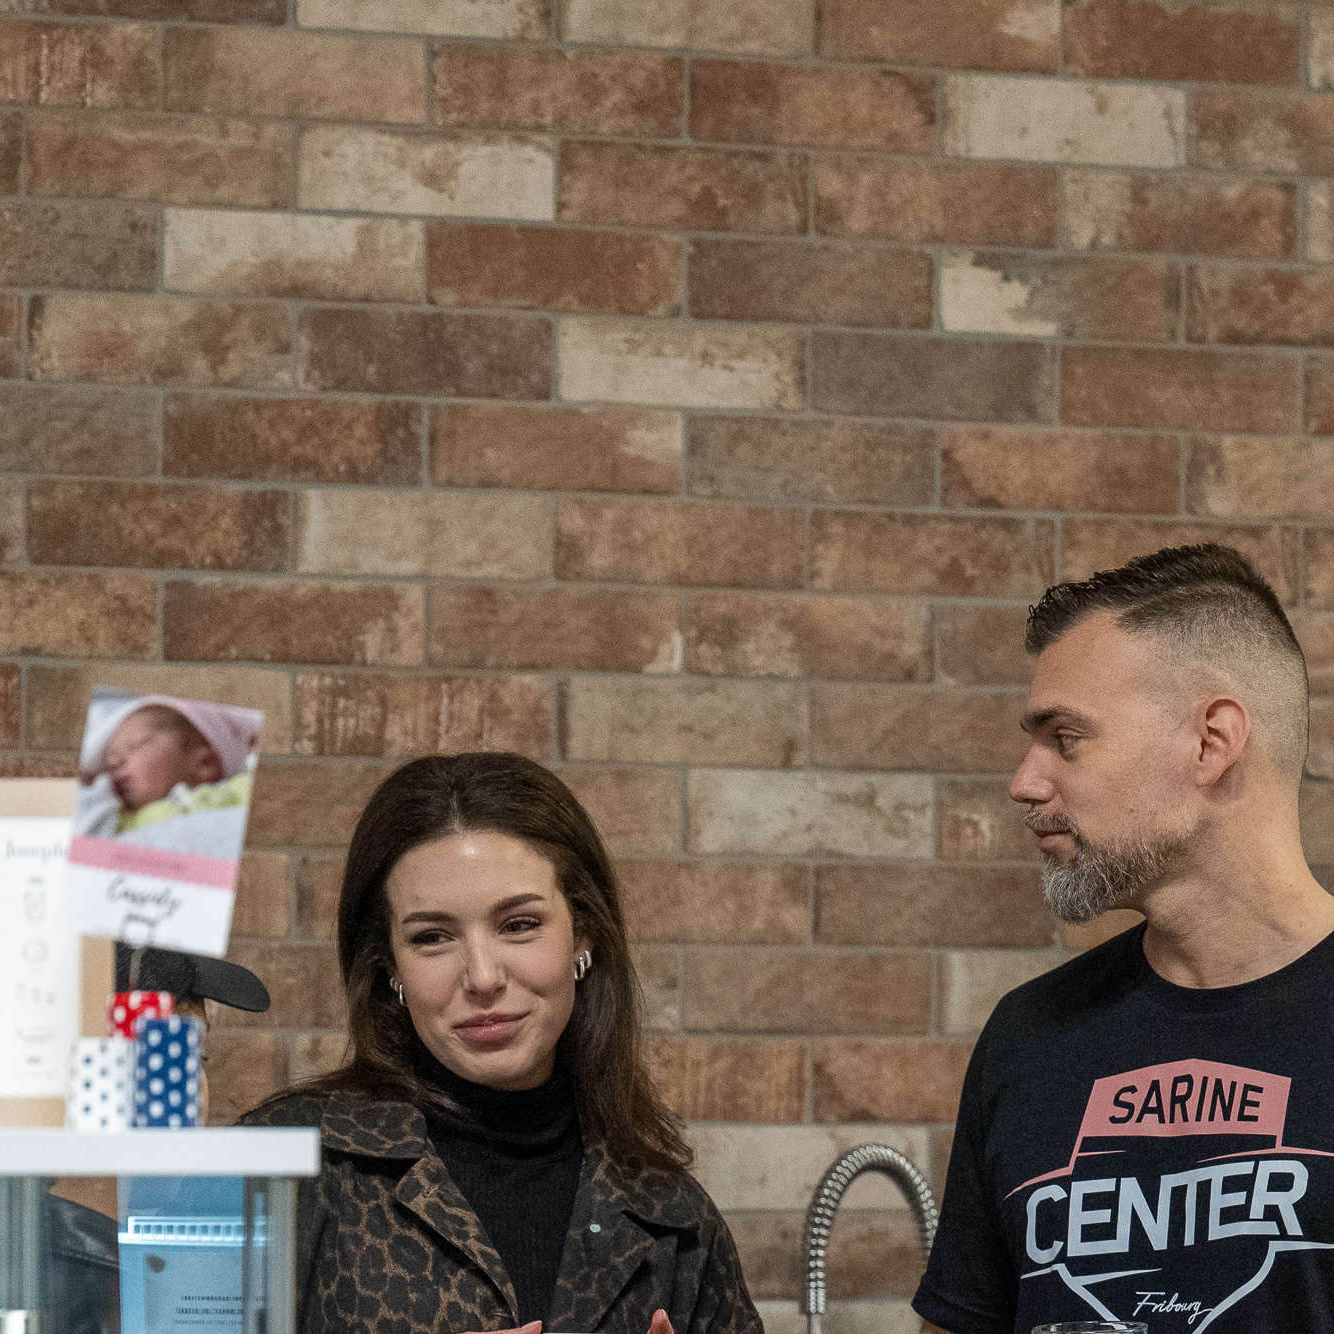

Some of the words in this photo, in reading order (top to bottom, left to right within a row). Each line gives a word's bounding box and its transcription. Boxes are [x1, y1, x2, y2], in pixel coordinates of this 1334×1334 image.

[1108, 1074, 1264, 1125] SARINE
[1025, 1159, 1309, 1264] CENTER
[1133, 1291, 1214, 1324] Fribourg
